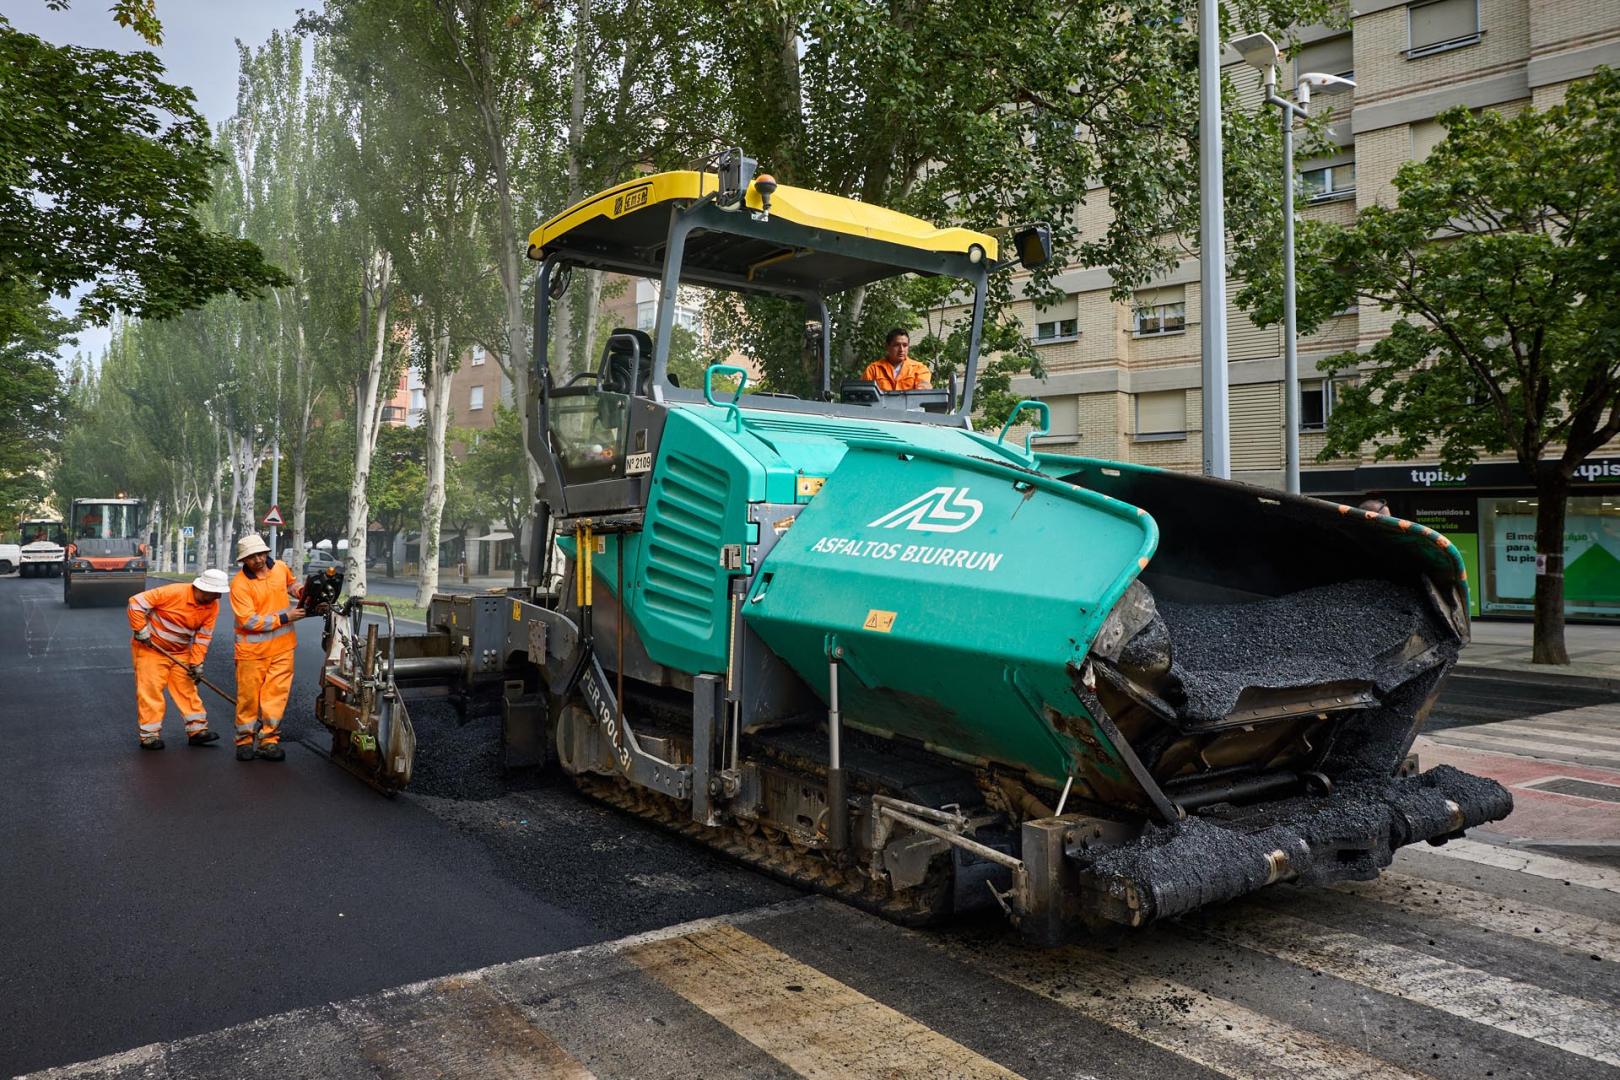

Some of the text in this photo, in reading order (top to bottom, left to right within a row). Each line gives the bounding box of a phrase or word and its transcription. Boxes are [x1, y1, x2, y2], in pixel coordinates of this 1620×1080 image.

[635, 456, 651, 469] 2109
[1573, 460, 1620, 481] upis
[1416, 508, 1464, 517] bienvenidos
[1506, 532, 1516, 541] El
[810, 536, 1004, 571] ASFALTOS BIURRUN
[1506, 544, 1530, 553] para
[1519, 554, 1537, 564] pis
[582, 668, 601, 707] PER
